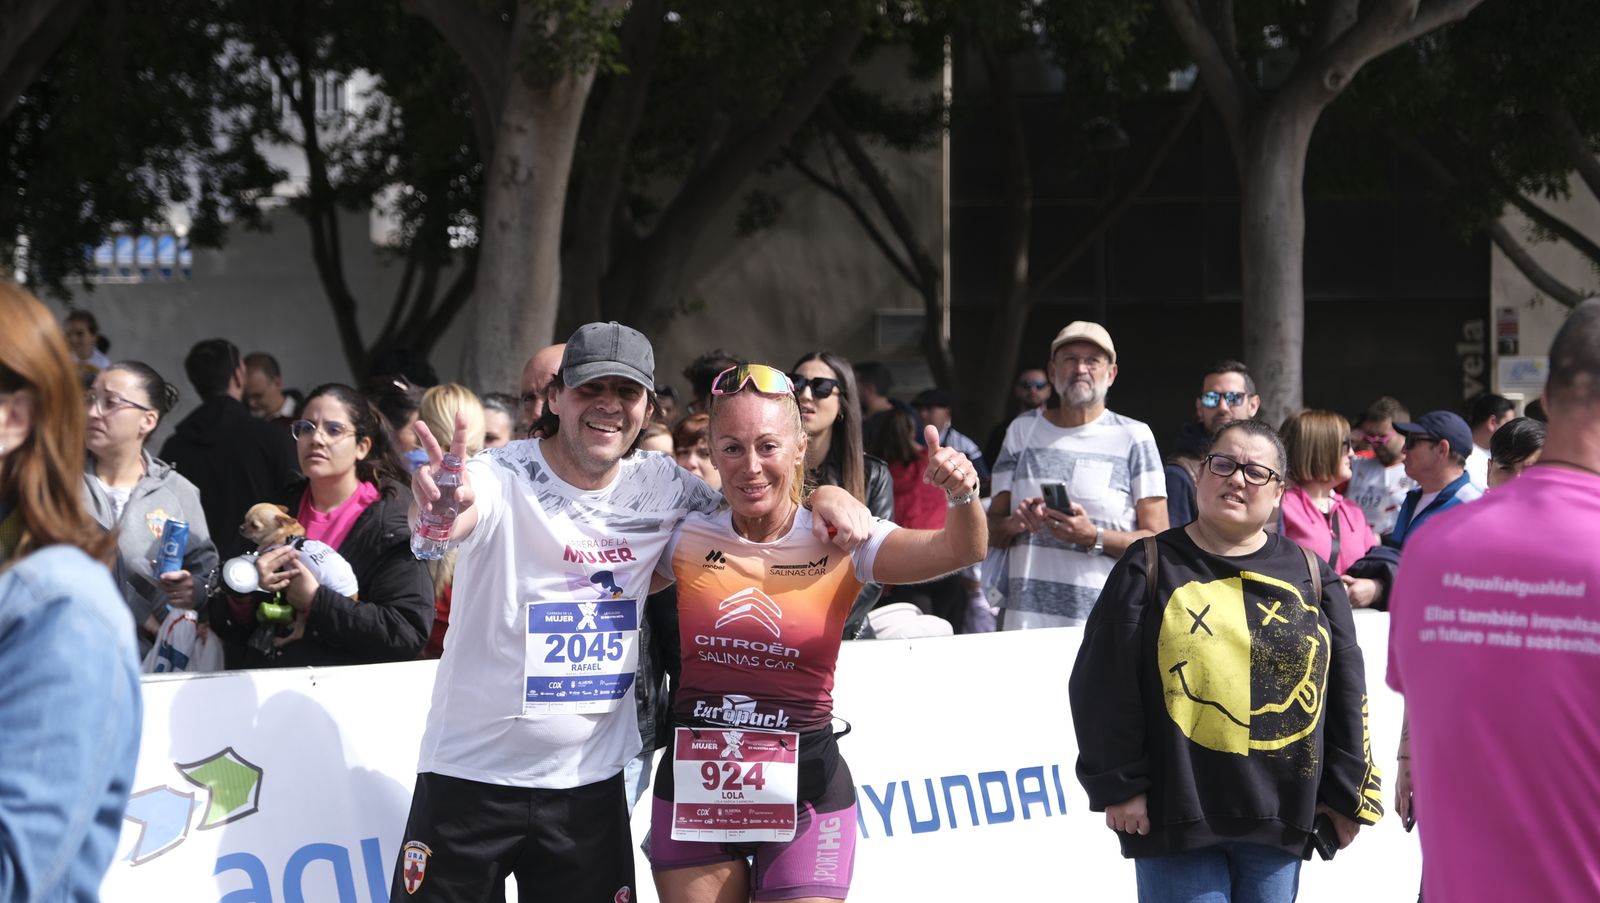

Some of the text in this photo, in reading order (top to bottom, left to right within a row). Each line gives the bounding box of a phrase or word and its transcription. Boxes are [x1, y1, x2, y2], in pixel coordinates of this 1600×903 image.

[601, 538, 614, 548] DE
[616, 538, 628, 546] LA
[563, 544, 637, 564] MUJER
[808, 568, 826, 576] CAR
[544, 615, 574, 623] MUJER
[1458, 608, 1529, 627] también
[1419, 629, 1436, 642] un
[1438, 627, 1485, 644] futuro
[1487, 631, 1522, 648] más
[544, 632, 624, 664] 2045
[571, 663, 602, 672] RAFAEL
[698, 651, 795, 670] SALINAS CAR
[693, 700, 790, 728] Europack
[691, 742, 718, 750] MUJER
[700, 761, 766, 791] 924
[721, 791, 744, 800] LOLA
[407, 851, 423, 860] URA
